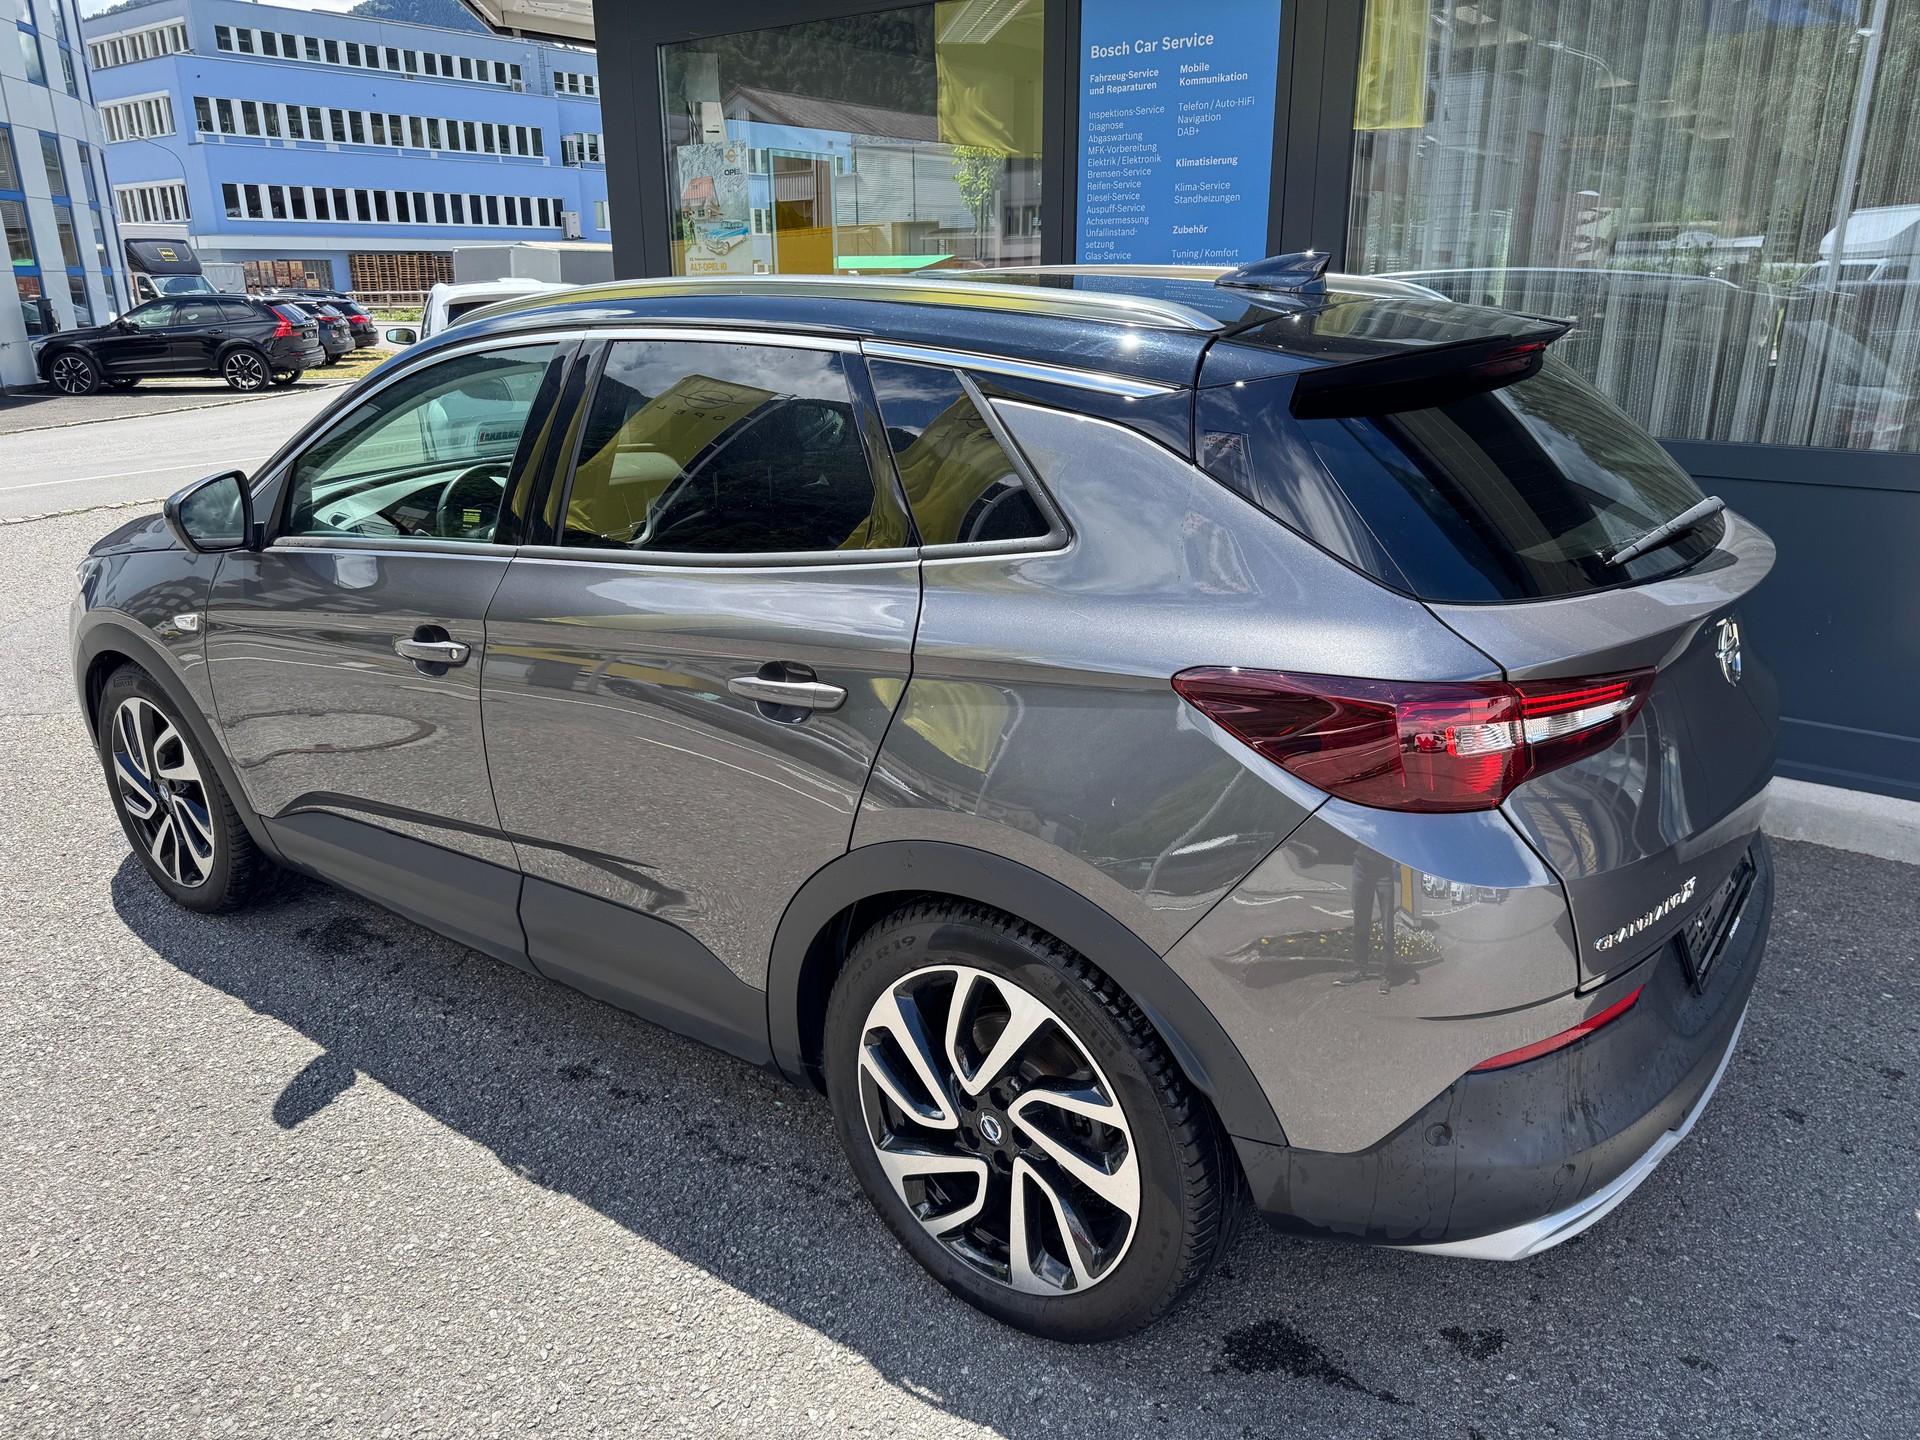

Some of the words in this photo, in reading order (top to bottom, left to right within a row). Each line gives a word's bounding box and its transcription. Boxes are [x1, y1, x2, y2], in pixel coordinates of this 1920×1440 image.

[1090, 41, 1130, 59] Bosch
[1134, 40, 1158, 54] Car
[1162, 32, 1214, 50] Service
[1180, 62, 1210, 74] Mobile
[1089, 69, 1159, 83] Fahrzeug-Service
[1179, 72, 1248, 86] Kommunikation
[1089, 85, 1105, 95] und
[1106, 82, 1157, 95] Reparaturen
[1088, 105, 1165, 119] Inspektions-Service
[1177, 113, 1221, 125] Navigation
[1088, 121, 1124, 132] Diagnose
[1177, 127, 1200, 137] DAB+
[1088, 132, 1143, 144] Abgaswartung
[1088, 143, 1158, 155] MFK-Vorbereitung
[1176, 156, 1238, 168] Klimatisierung
[1087, 167, 1152, 179] Bremsen-Service
[1087, 180, 1142, 191] Reifen-Service
[1174, 181, 1231, 192] Klima-Service
[1087, 192, 1141, 203] Diesel-Service
[1174, 193, 1241, 204] Standheizungen
[1086, 204, 1146, 216] Auspuff-Service
[1086, 216, 1149, 227] Achsvermessung
[1086, 227, 1138, 238] Unfallinstand-
[1172, 224, 1208, 235] Zubehör
[1085, 240, 1115, 251] setzung
[1085, 251, 1132, 261] Glas-Service
